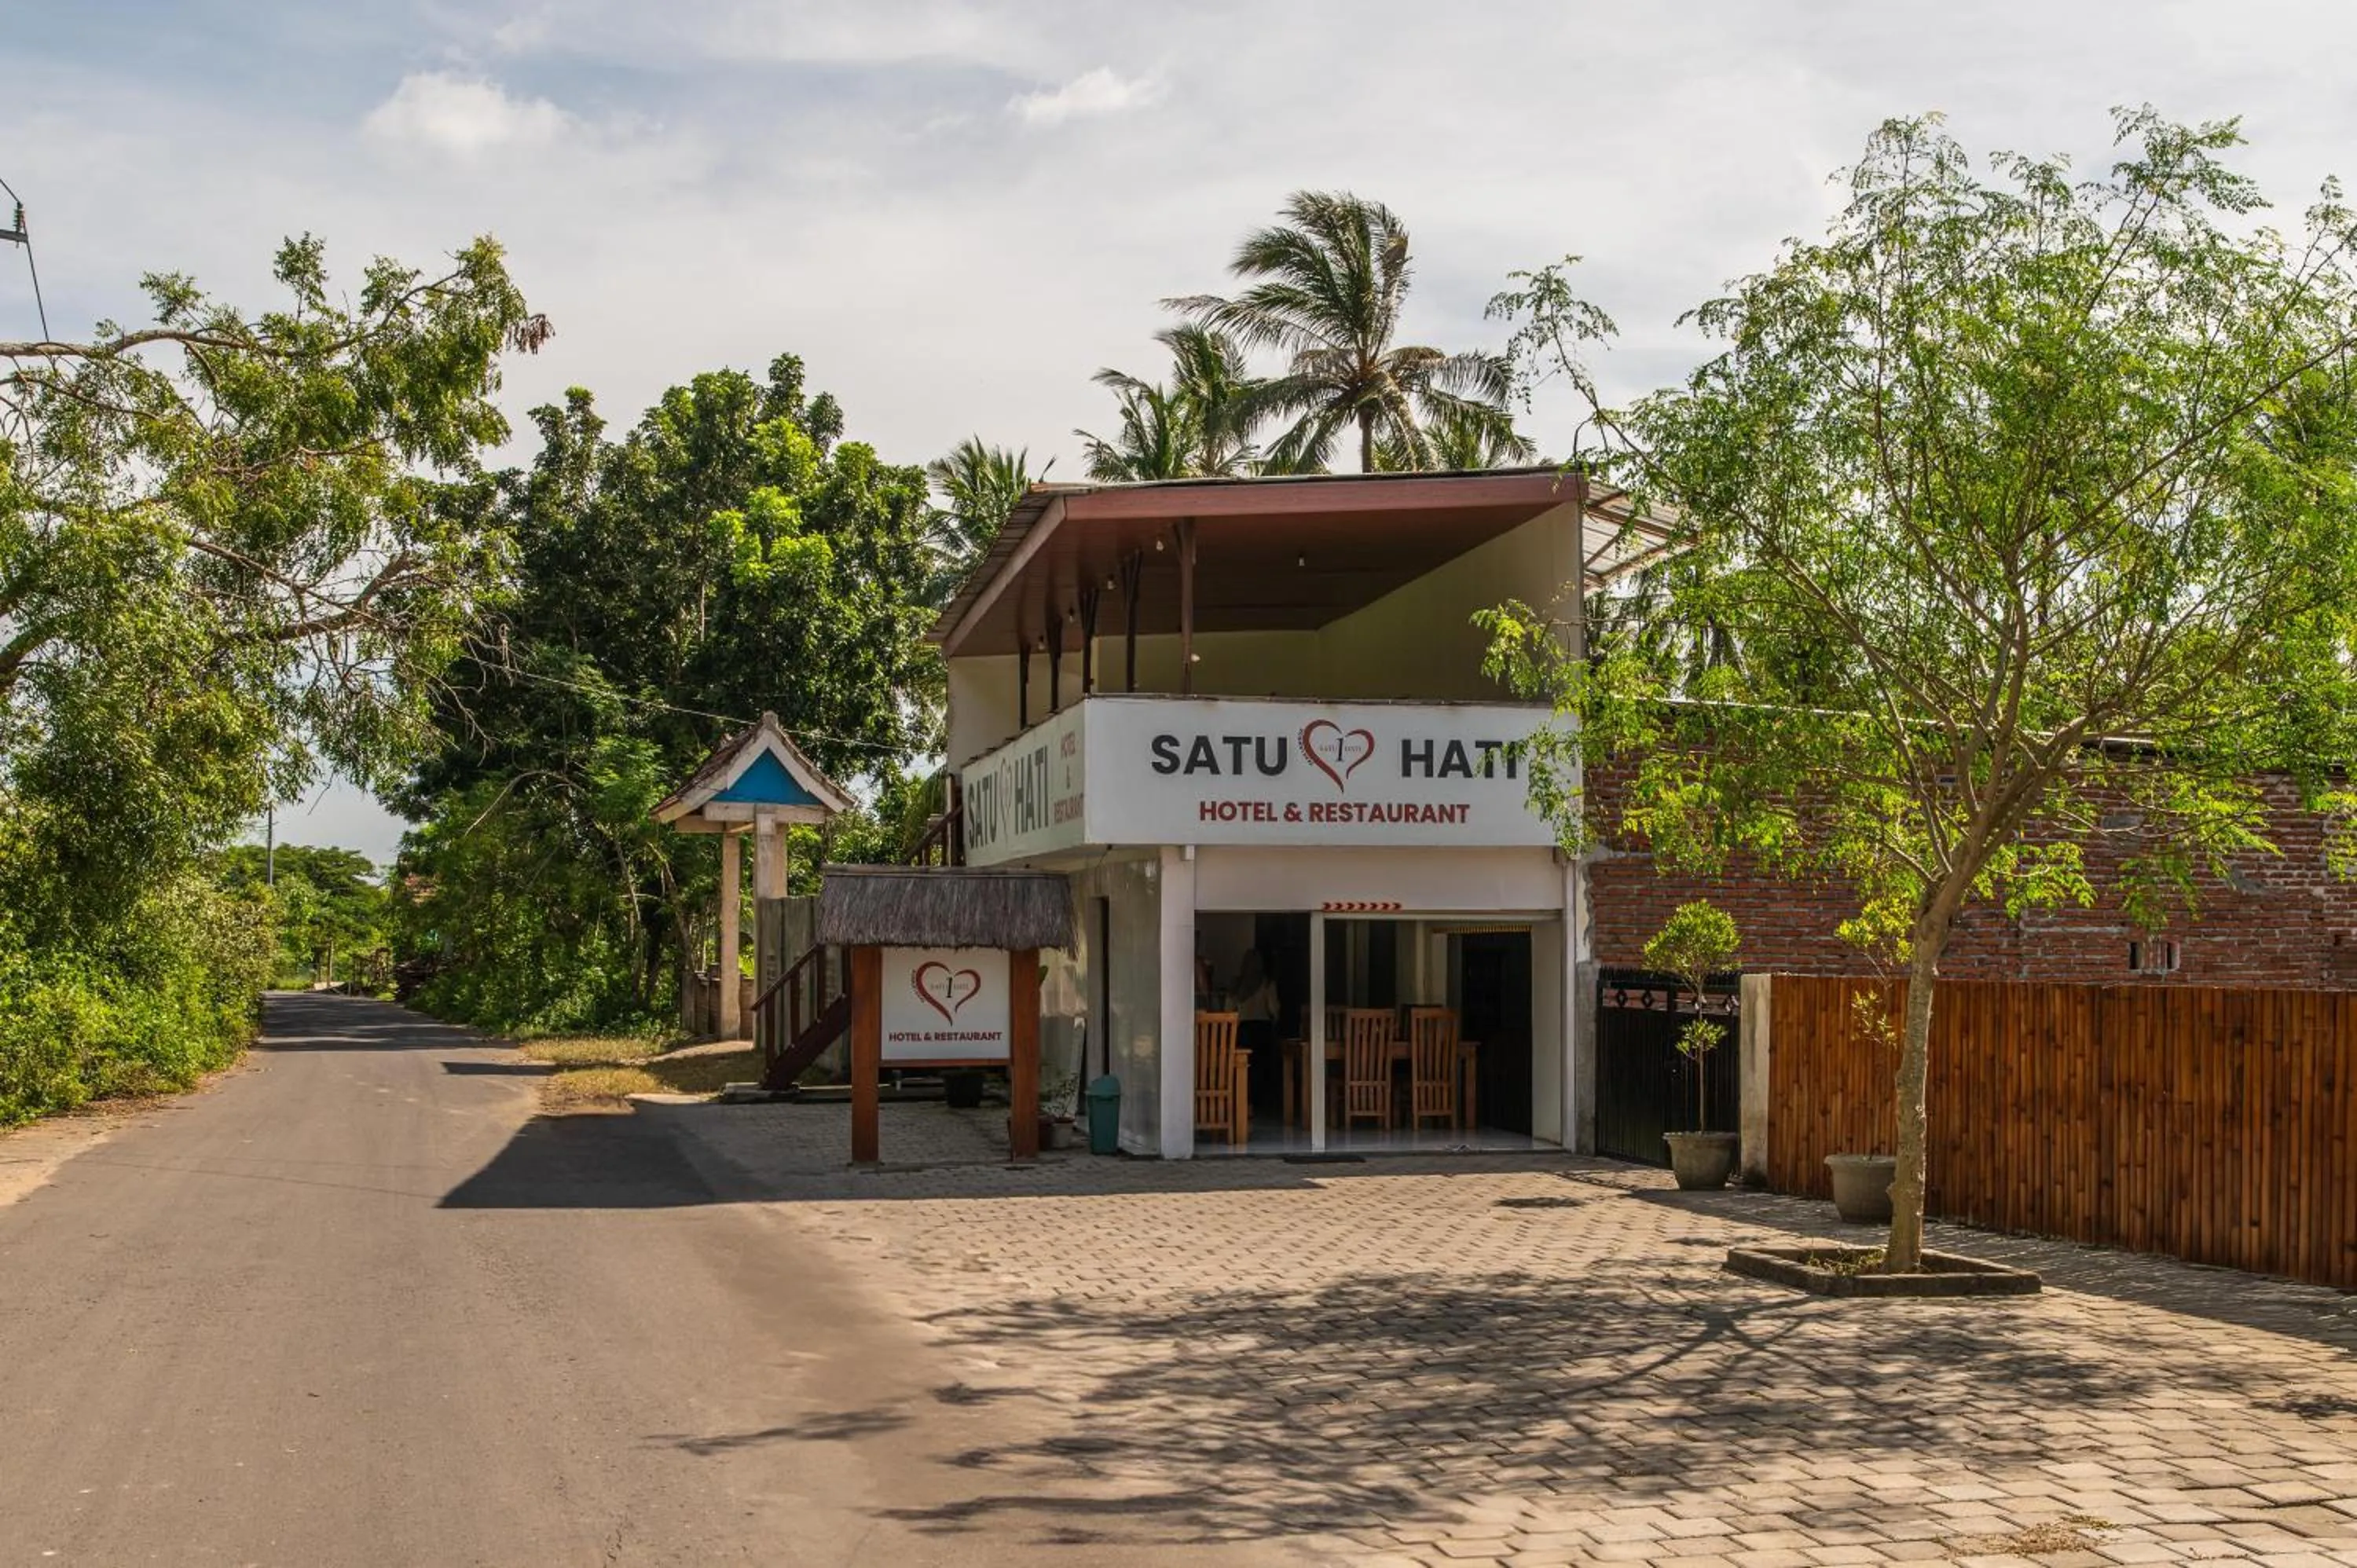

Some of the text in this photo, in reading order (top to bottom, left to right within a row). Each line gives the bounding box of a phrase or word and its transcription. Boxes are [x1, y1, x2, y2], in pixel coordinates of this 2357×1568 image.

[1151, 734, 1288, 777] SATU
[1401, 738, 1517, 779] HATI
[968, 745, 1049, 849] SATU HATI
[1199, 800, 1471, 824] HOTEL & RESTAURANT
[889, 1031, 1003, 1042] HOTEL & RESTAURANT
